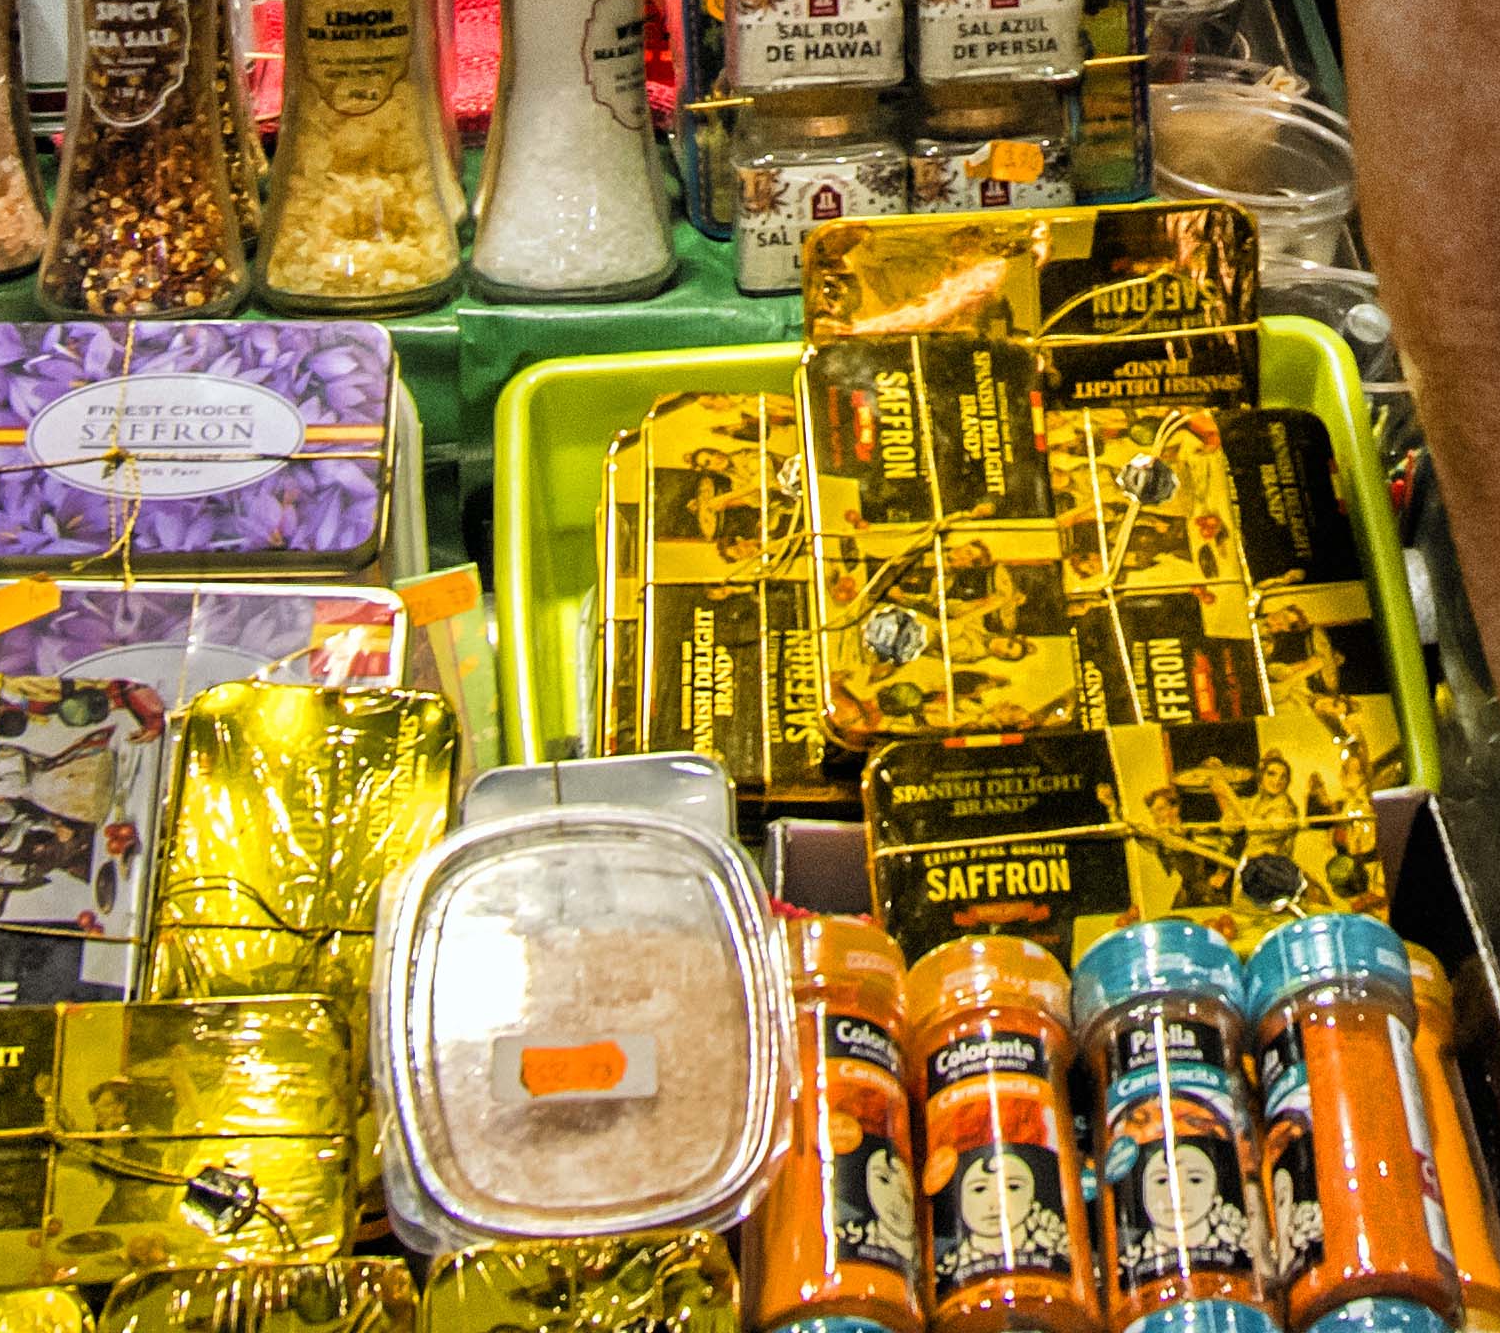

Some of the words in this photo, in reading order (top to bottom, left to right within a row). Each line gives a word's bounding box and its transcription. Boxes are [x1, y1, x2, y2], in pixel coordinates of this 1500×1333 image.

[96, 0, 160, 22] SPICY
[324, 8, 394, 28] LEMON
[127, 27, 173, 47] SALT
[778, 20, 815, 39] SAL
[821, 18, 869, 39] ROJA
[956, 18, 995, 37] SAL
[1000, 15, 1050, 36] AZUL
[766, 44, 796, 62] DE
[802, 40, 882, 62] HAWAI
[952, 41, 982, 60] DE
[988, 35, 1059, 58] PERSIA
[756, 229, 792, 248] SAL
[972, 349, 997, 412] SPANISH
[1073, 377, 1161, 400] DELIGHT
[86, 404, 162, 416] FINEST
[166, 403, 255, 417] CHOICE
[79, 418, 256, 442] SAFFRON
[875, 370, 918, 480] SAFFRON
[982, 414, 1006, 495] DELIGHT
[695, 606, 715, 680] DELIGHT
[891, 776, 980, 805] SPANISH
[985, 772, 1084, 800] DELIGHT
[1009, 843, 1067, 858] QUALITY
[927, 857, 1071, 903] SAFFRON
[936, 1036, 1037, 1074] Colorante
